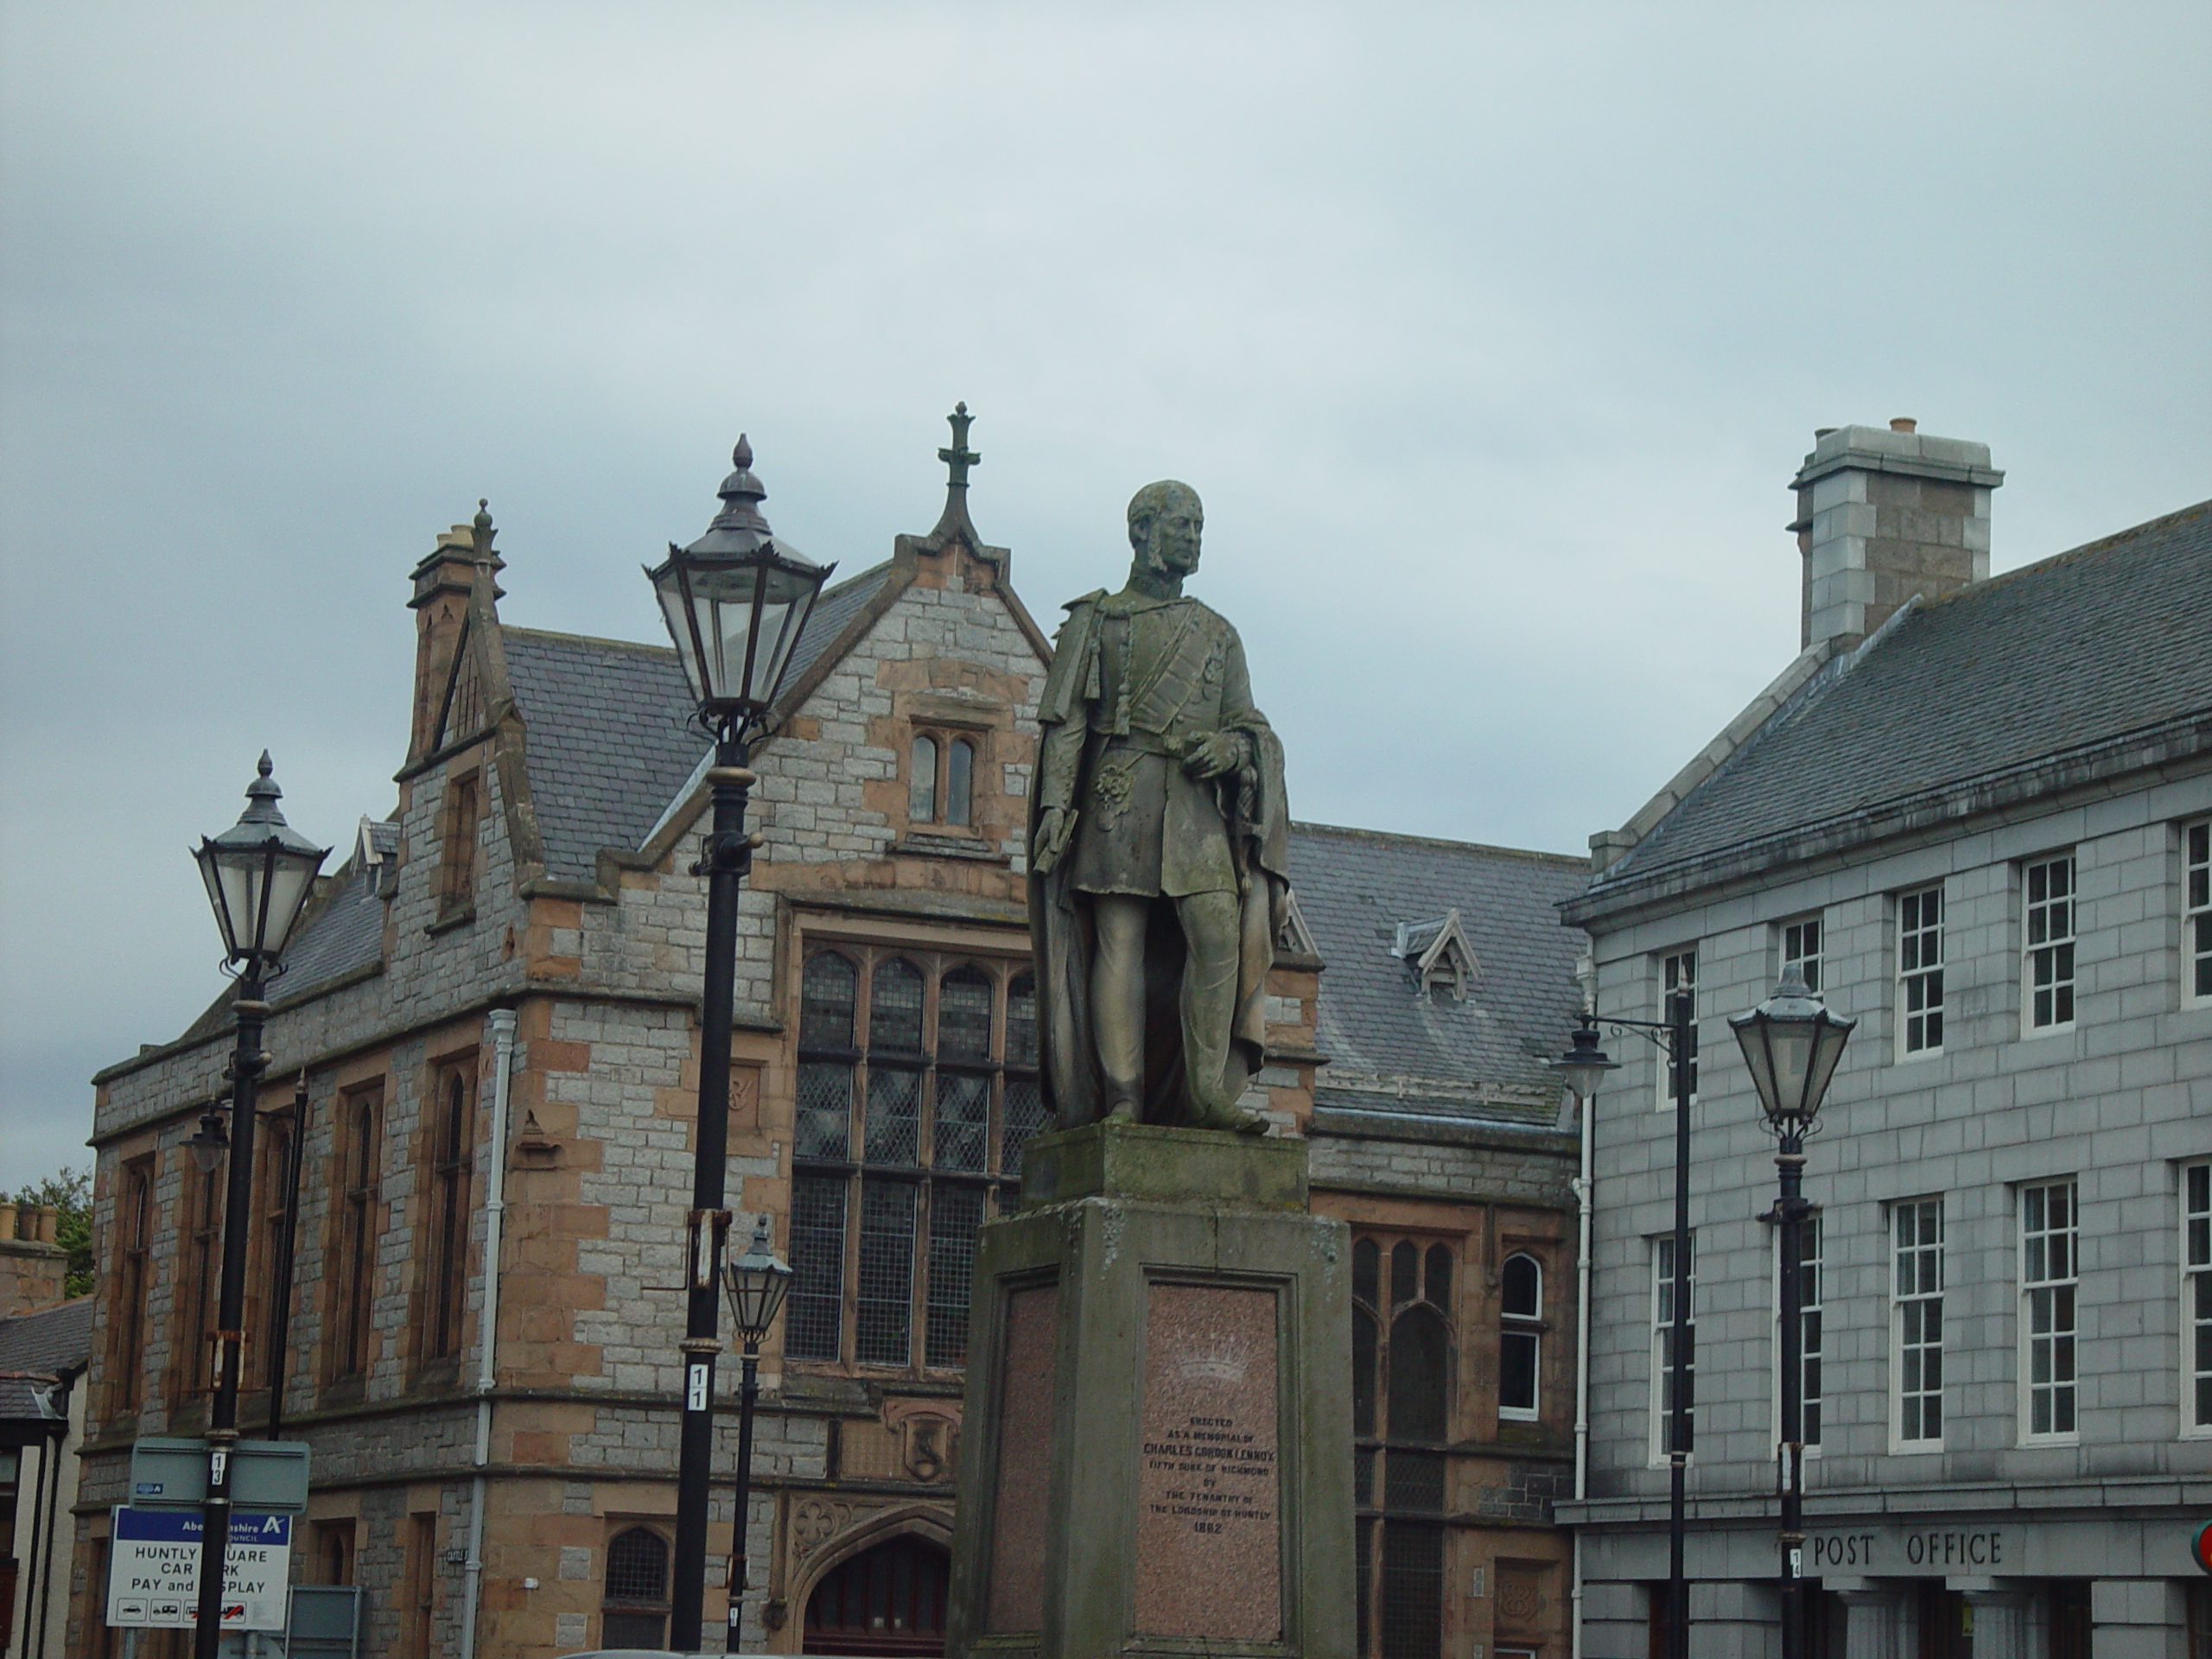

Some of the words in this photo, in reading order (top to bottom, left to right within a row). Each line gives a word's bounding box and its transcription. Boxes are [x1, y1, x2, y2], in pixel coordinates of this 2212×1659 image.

[1190, 1416, 1233, 1427] ERECTED
[1166, 1430, 1180, 1440] AS
[1183, 1431, 1190, 1440] A
[1193, 1431, 1241, 1443] MEMORIAL
[1144, 1442, 1192, 1457] CHARLES
[1194, 1446, 1233, 1459] GORDON
[1235, 1447, 1274, 1462] LENNOX
[1149, 1459, 1174, 1470] FIFTH
[1179, 1461, 1202, 1471] DUKE
[1205, 1463, 1217, 1472] OF
[1221, 1464, 1269, 1476] RICHMOND
[1203, 1476, 1216, 1487] BY
[1166, 1491, 1185, 1500] THE
[1189, 1491, 1241, 1503] TENANTRY
[1149, 1503, 1167, 1514] THE
[1172, 1505, 1218, 1516] LORDSHIP
[1221, 1509, 1232, 1517] OF
[1235, 1510, 1271, 1521] HUNTLY
[182, 1521, 259, 1534] Abeshire
[136, 1548, 197, 1560] HUNTLY
[226, 1550, 267, 1563] UARE
[1815, 1534, 1874, 1566] POST
[1907, 1532, 2001, 1564] OFFICE
[161, 1563, 193, 1575] CAR
[222, 1565, 239, 1577] RK
[131, 1579, 162, 1591] PAY
[168, 1580, 194, 1592] and
[220, 1582, 265, 1593] SPLAY
